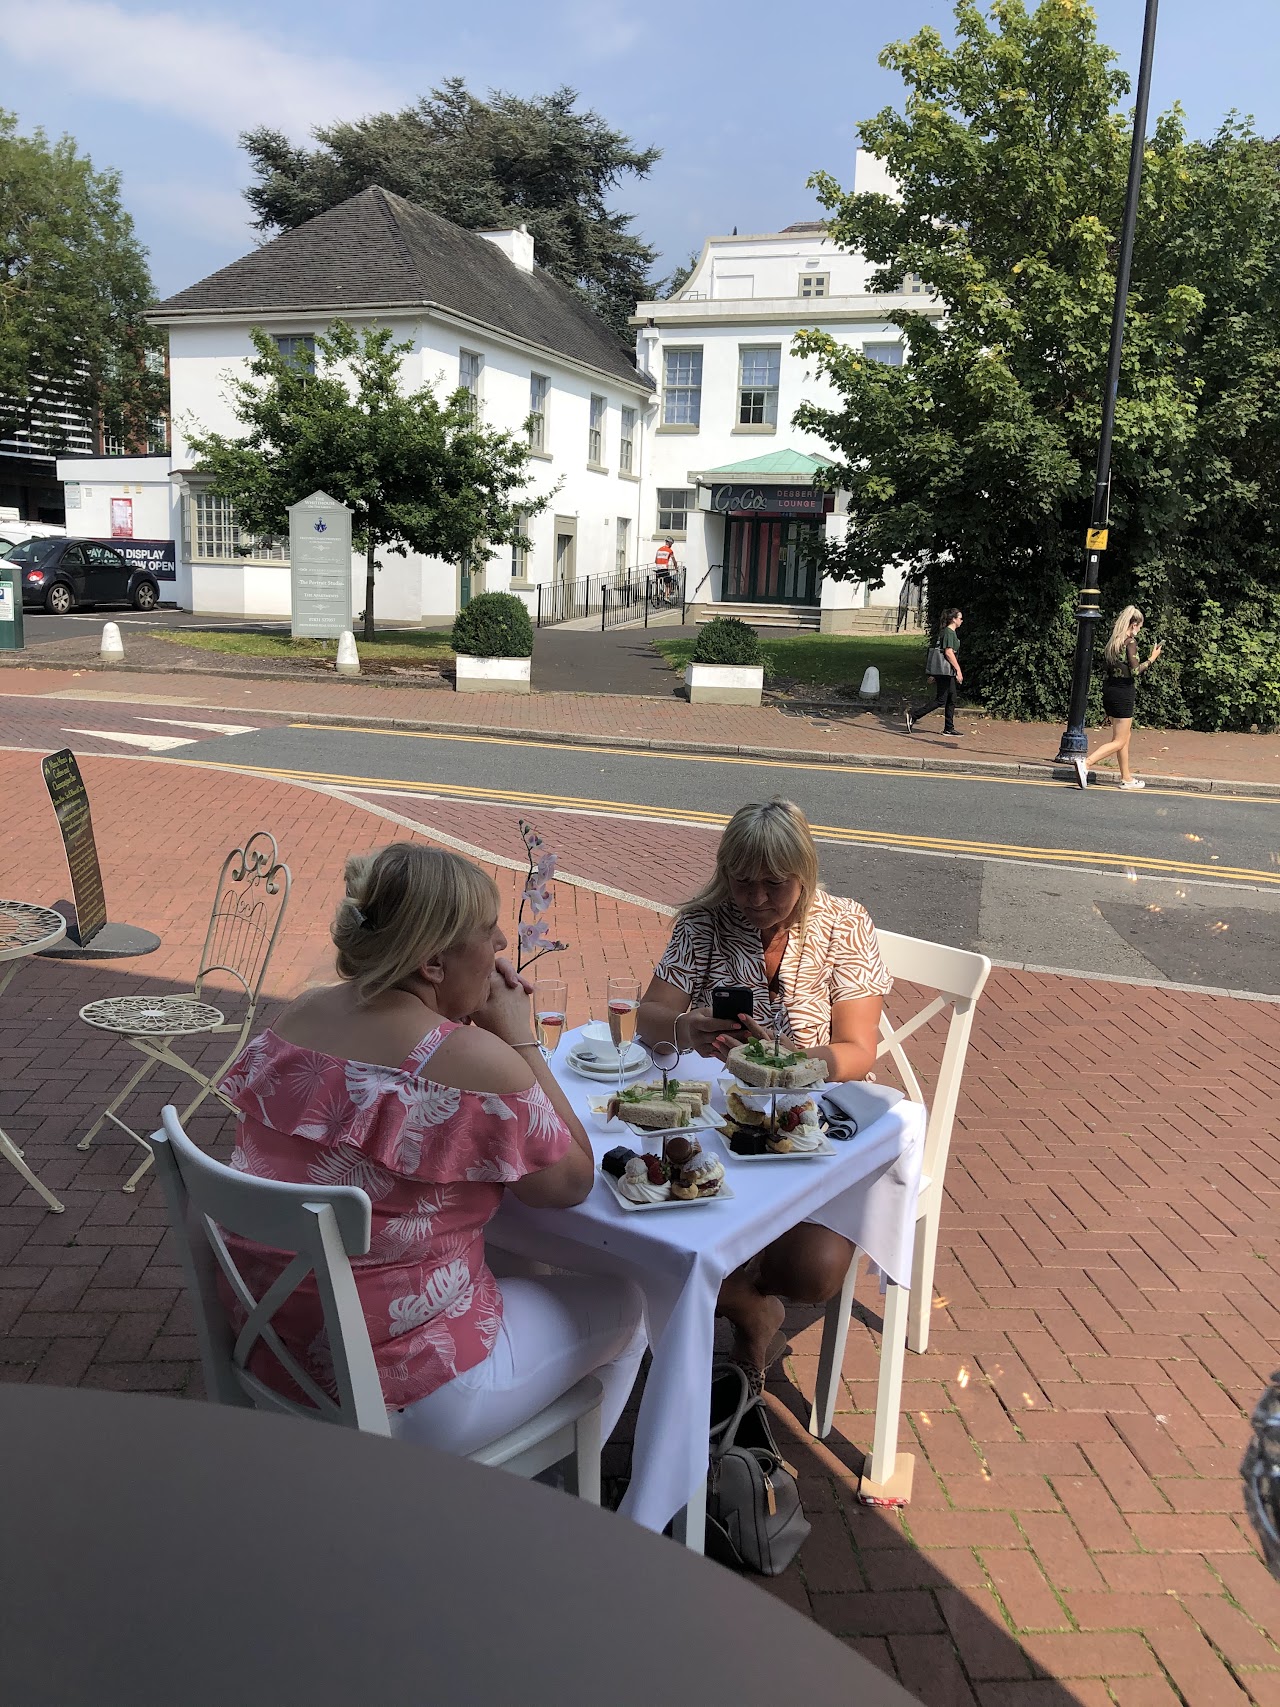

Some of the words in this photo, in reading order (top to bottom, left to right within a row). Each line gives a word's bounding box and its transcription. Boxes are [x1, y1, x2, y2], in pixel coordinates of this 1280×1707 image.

[777, 490, 818, 498] DESSERT
[778, 500, 816, 508] LOUNGE
[125, 548, 165, 560] DISPLAY
[148, 561, 175, 571] OPEN
